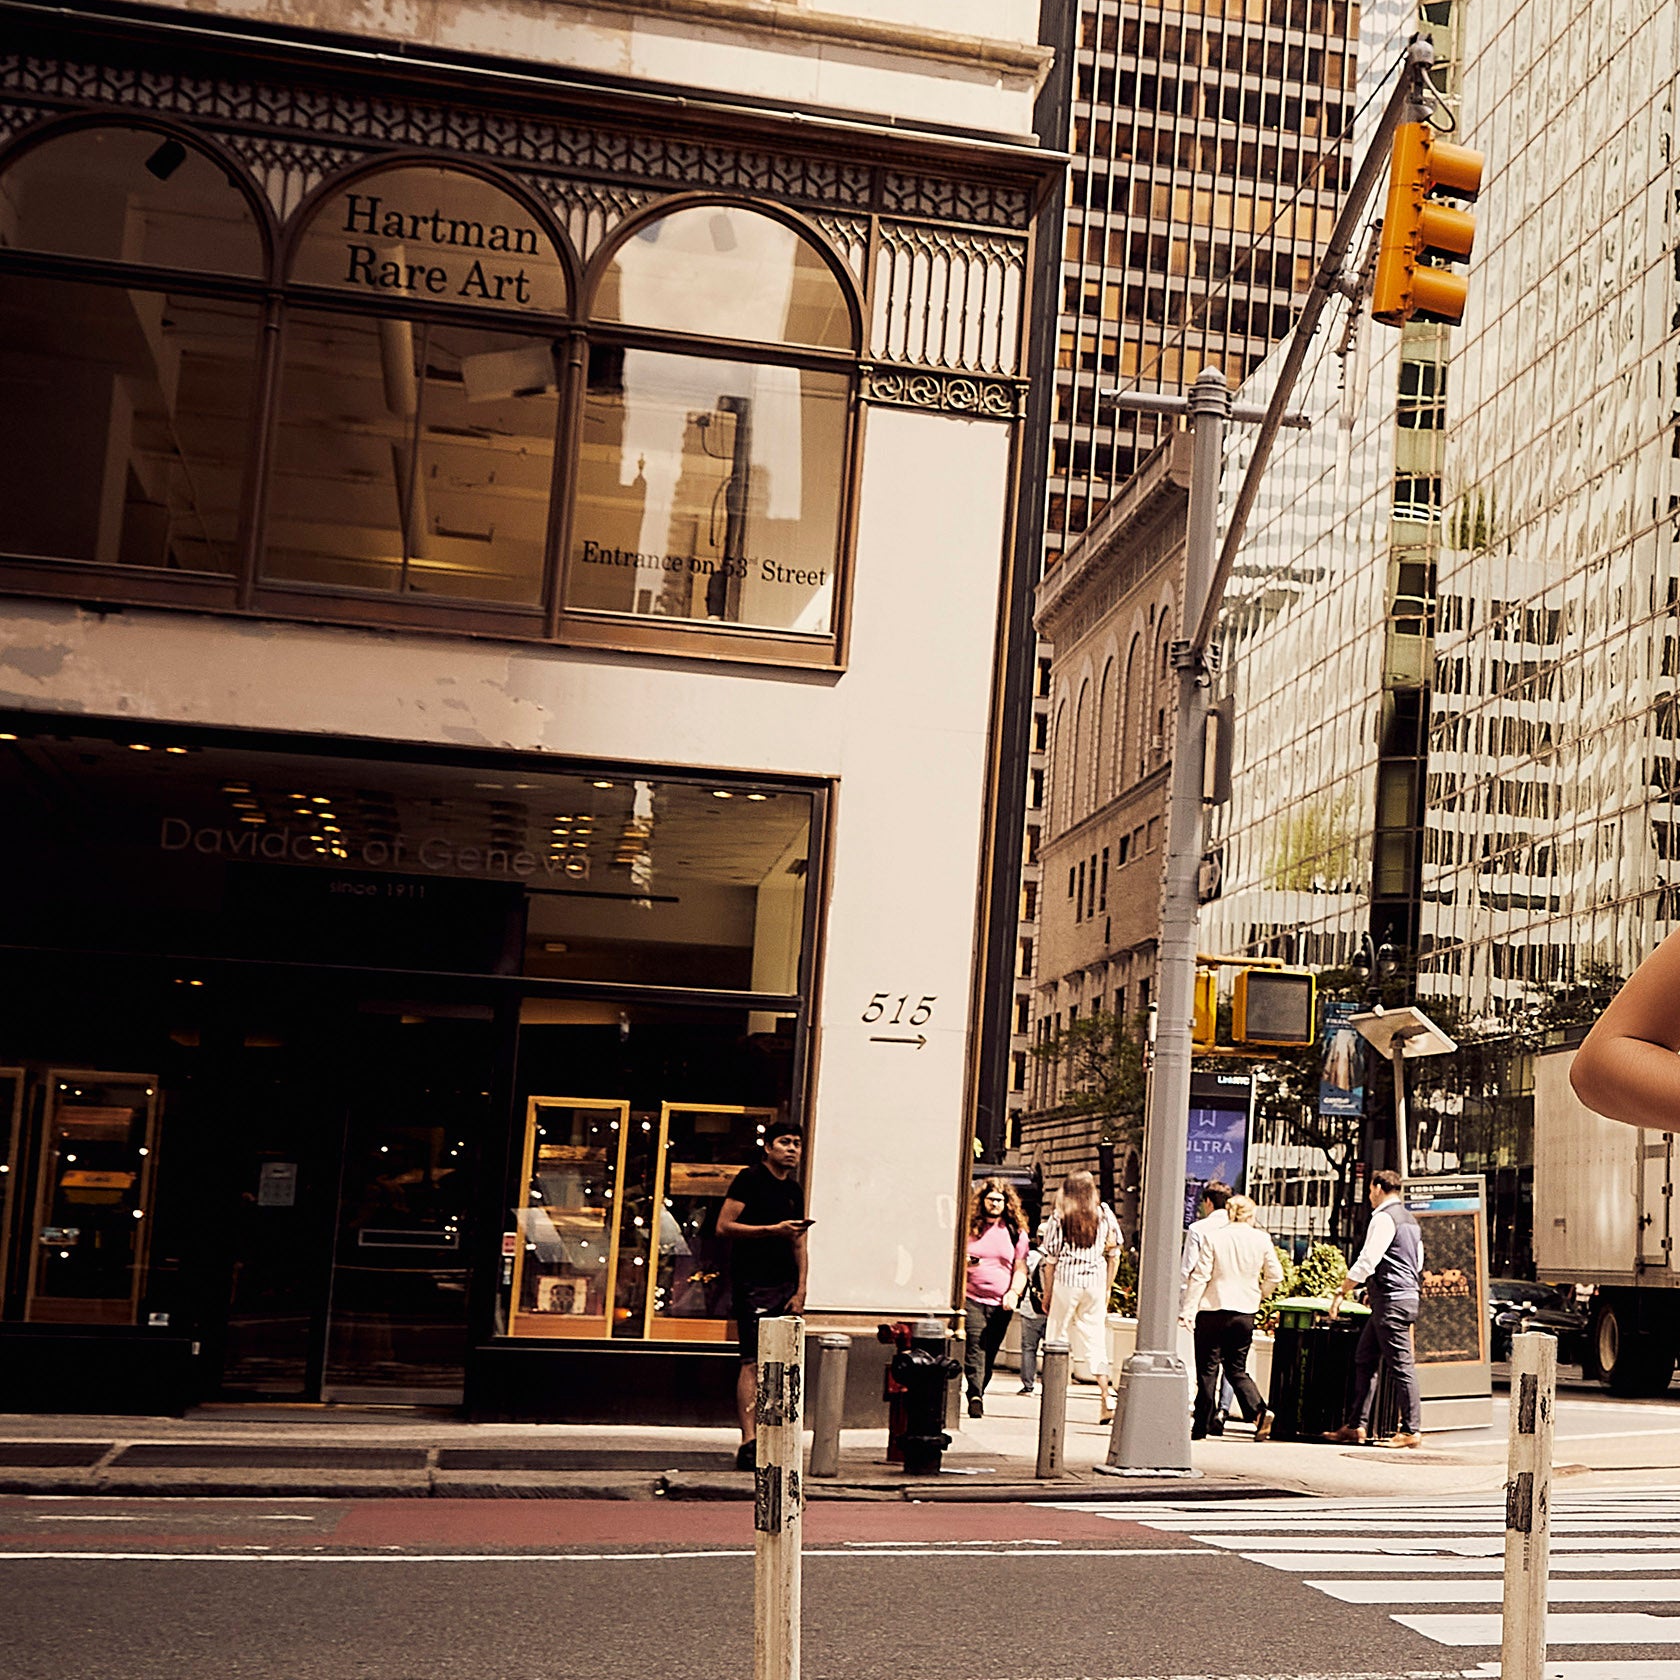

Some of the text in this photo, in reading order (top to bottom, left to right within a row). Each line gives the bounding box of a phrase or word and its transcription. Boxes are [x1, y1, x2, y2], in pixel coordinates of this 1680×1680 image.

[342, 194, 539, 255] Hartman
[344, 244, 531, 304] Rare Art
[582, 540, 683, 571] Entrance
[690, 559, 714, 575] on
[761, 559, 827, 586] Street
[418, 838, 592, 883] Geneva
[861, 992, 938, 1026] 515
